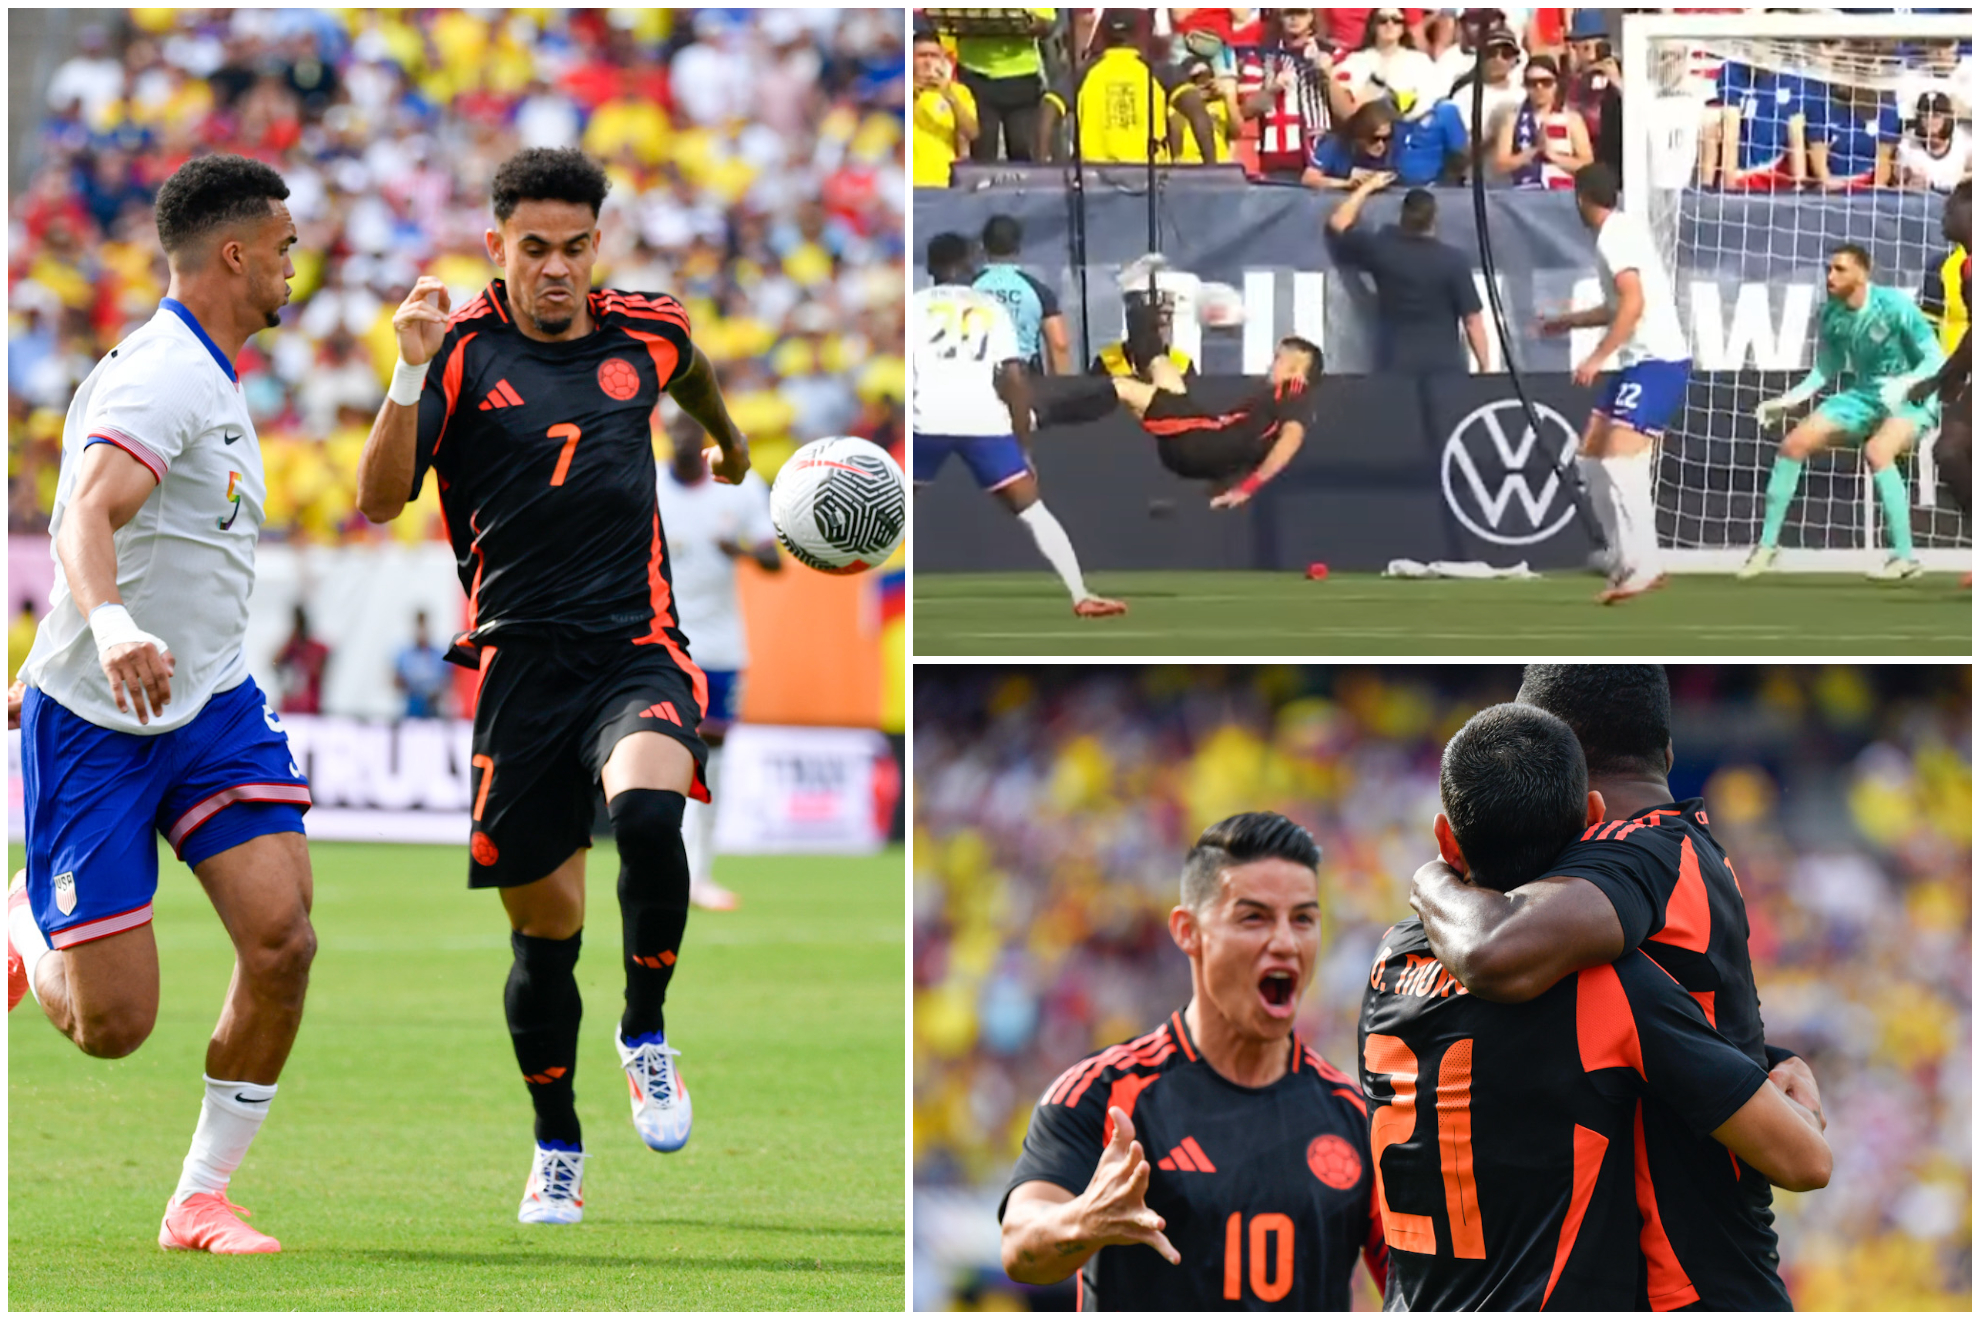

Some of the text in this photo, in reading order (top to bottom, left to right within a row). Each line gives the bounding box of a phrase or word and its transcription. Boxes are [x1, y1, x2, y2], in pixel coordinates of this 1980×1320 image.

[927, 303, 992, 361] 20
[546, 422, 582, 486] 7
[215, 470, 242, 531] 5
[472, 753, 494, 821] 7
[56, 874, 73, 892] USA
[1363, 1033, 1486, 1260] 21
[1223, 1211, 1295, 1302] 10
